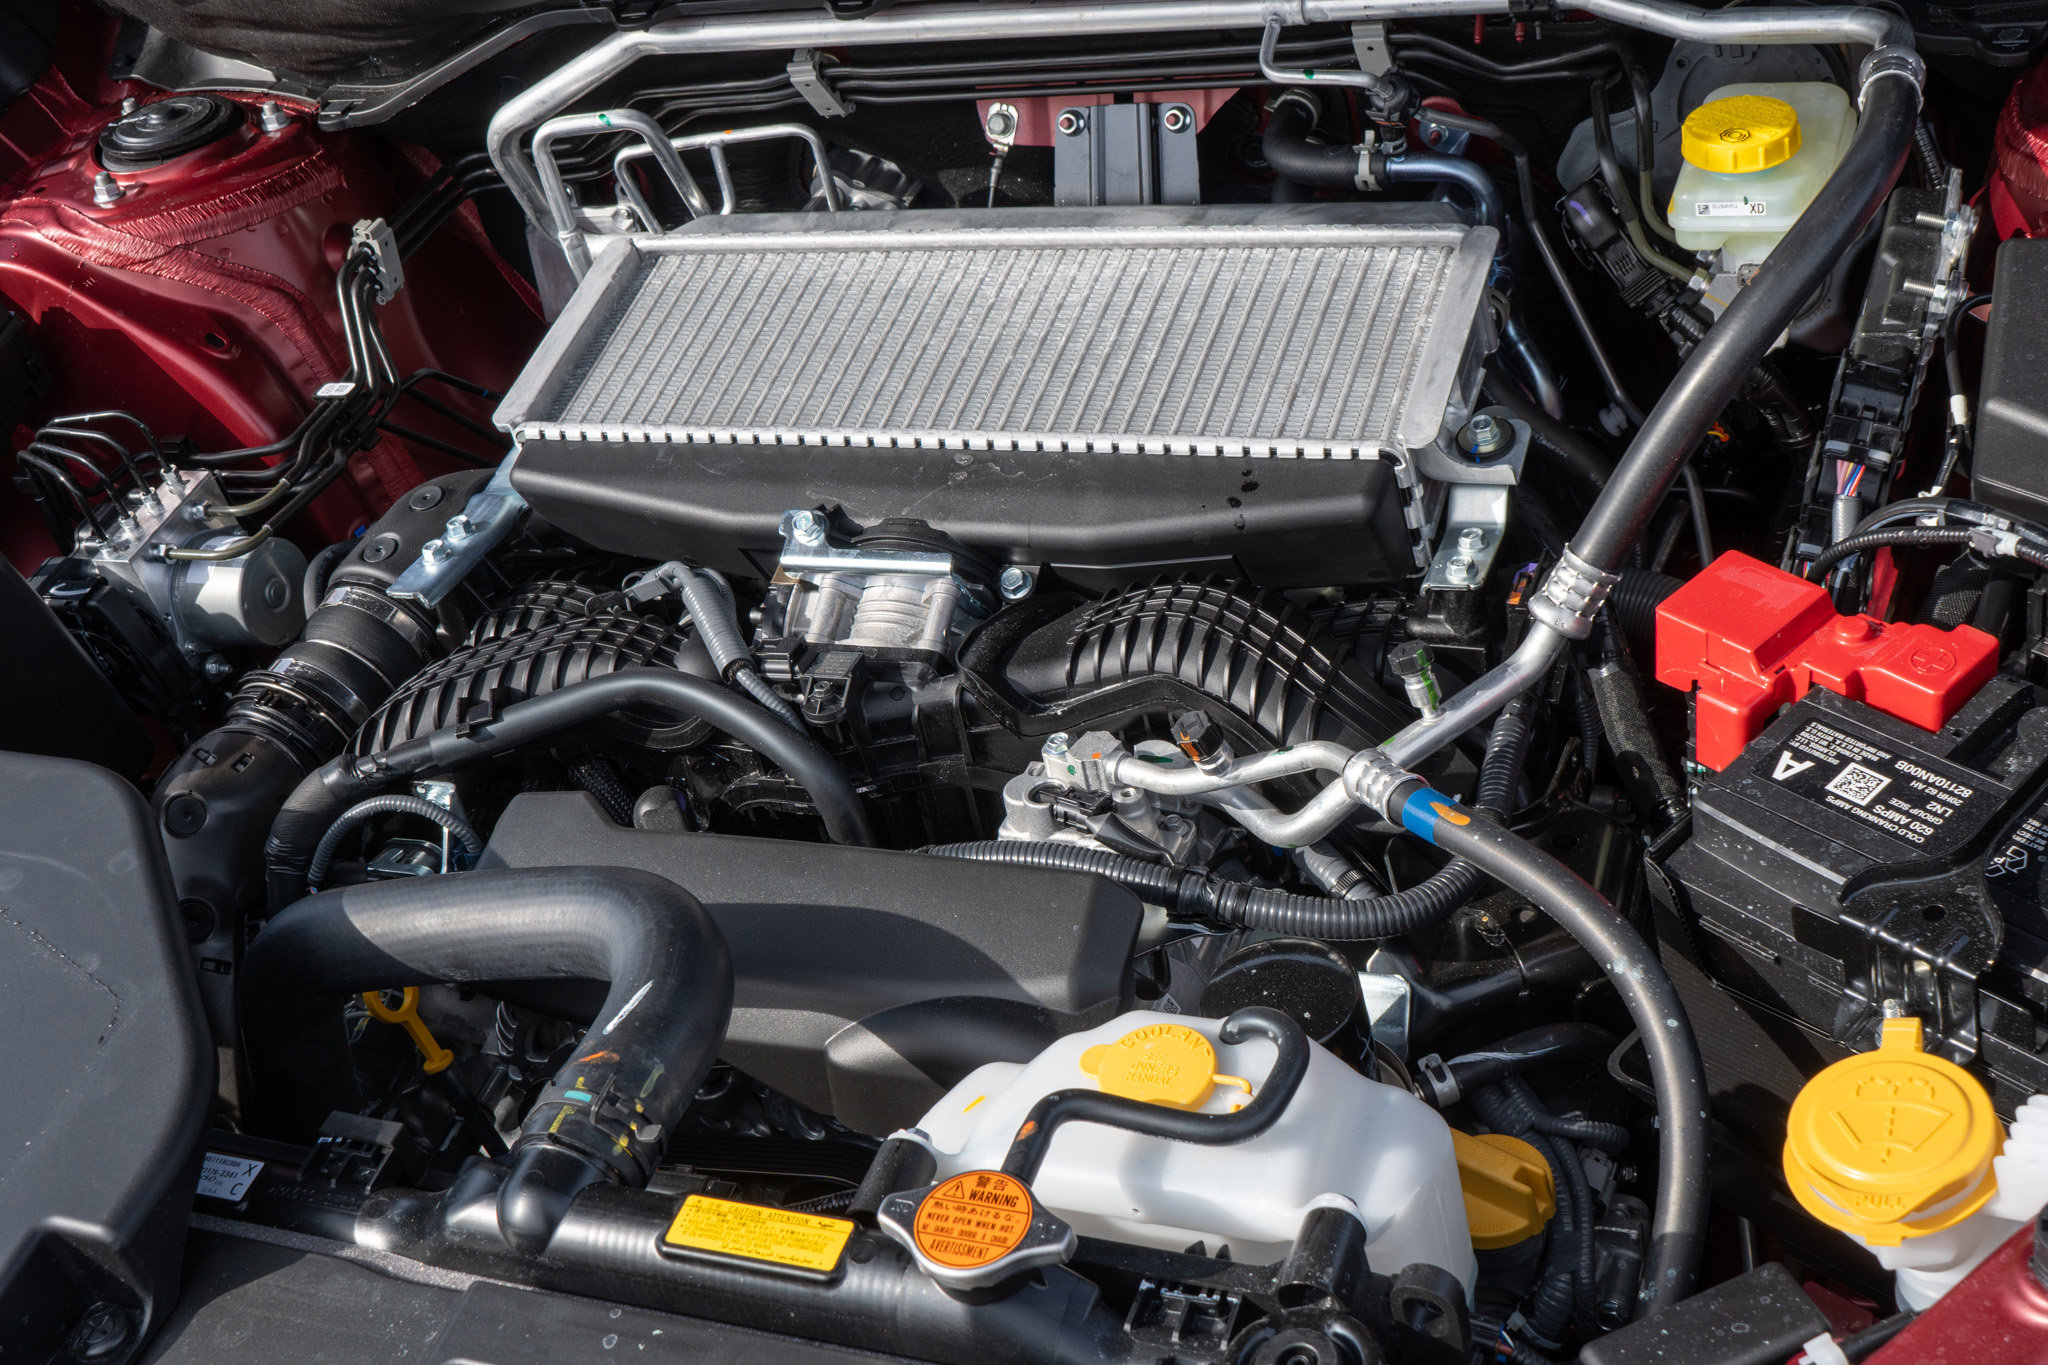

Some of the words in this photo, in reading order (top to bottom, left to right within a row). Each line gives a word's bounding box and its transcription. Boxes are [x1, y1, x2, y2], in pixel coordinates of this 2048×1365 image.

[1750, 203, 1765, 214] XD
[1810, 722, 1846, 740] MATERIALS
[1815, 731, 1834, 742] WITH
[1844, 737, 1878, 753] IMPORTED
[1798, 744, 1840, 765] DISTRIBUTED
[1859, 750, 1880, 761] MADE
[1876, 750, 1892, 759] AND
[1771, 750, 1815, 781] A
[1894, 760, 1973, 798] 82110AN00B
[1909, 780, 1927, 790] AH
[1924, 786, 1938, 795] 62
[1936, 791, 1963, 806] 20HR
[1825, 795, 1853, 810] AMPS
[1888, 797, 1911, 810] SIZE
[1926, 801, 1953, 817] LN2
[1851, 807, 1899, 831] CRANKING
[1872, 804, 1912, 824] AMPS
[1909, 808, 1943, 825] GROUP
[1897, 828, 1925, 843] COLD
[1909, 821, 1934, 835] 620
[1120, 1026, 1211, 1057] COOLANT
[242, 1163, 258, 1177] X
[230, 1182, 244, 1196] C
[975, 1175, 1009, 1192] 警告
[969, 1188, 1020, 1208] WARNING
[1855, 1193, 1906, 1209] PULL
[728, 1205, 762, 1219] CAUTION
[767, 1211, 809, 1225] ATTENTION
[927, 1212, 950, 1222] NEVER
[952, 1216, 972, 1226] OPEN
[975, 1220, 996, 1230] WHEN
